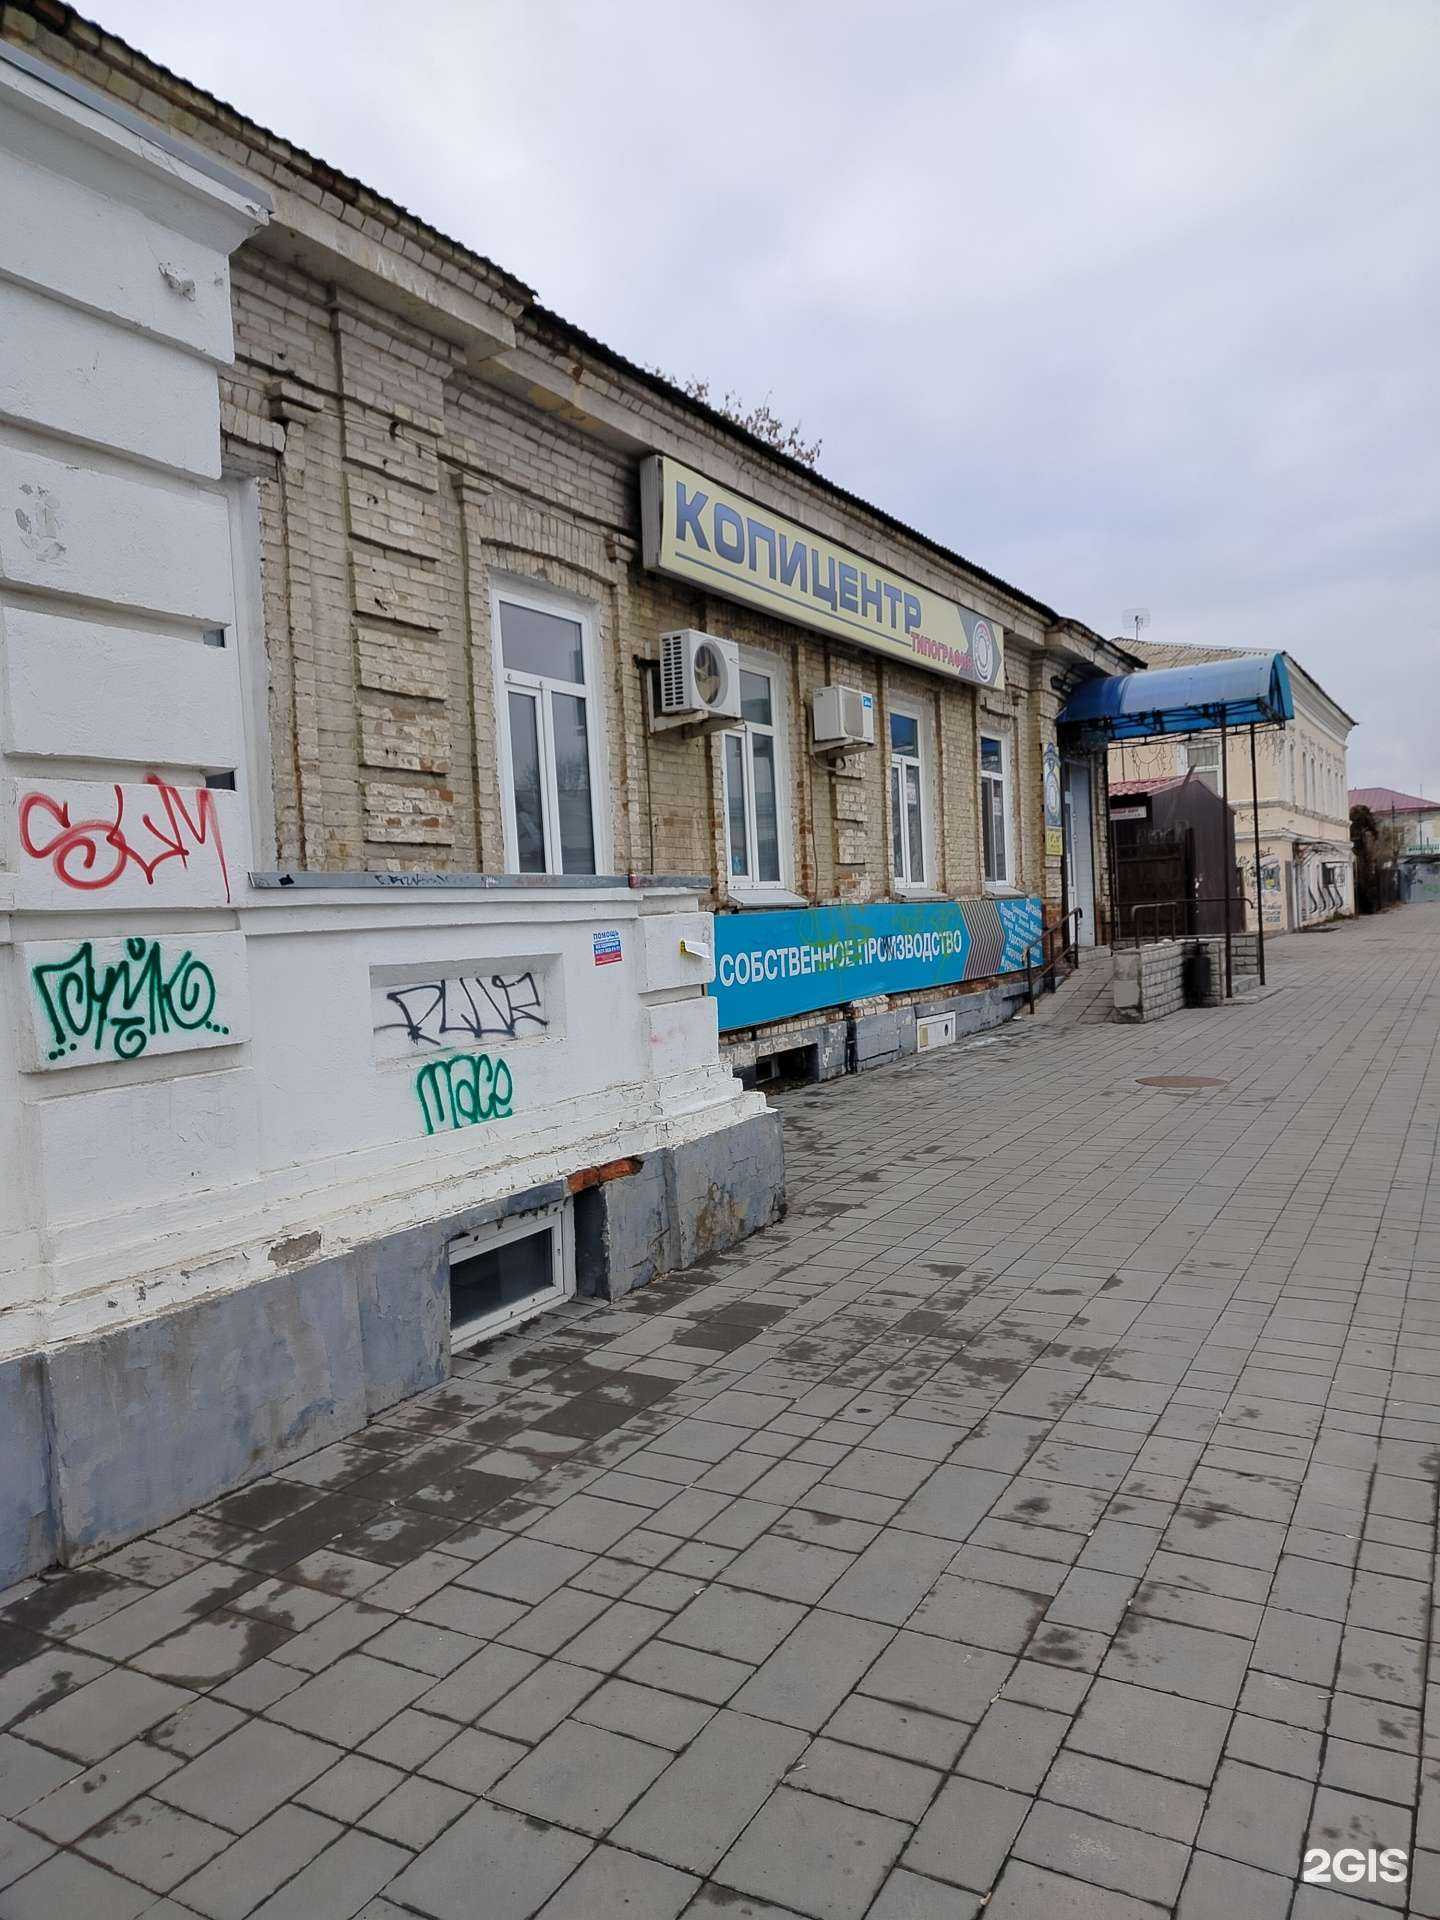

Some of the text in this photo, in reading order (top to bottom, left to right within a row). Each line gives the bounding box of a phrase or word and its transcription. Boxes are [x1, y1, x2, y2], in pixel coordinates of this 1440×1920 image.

[675, 480, 923, 635] КОПИЦЕНТР
[910, 631, 974, 671] ТИПОГРАФИЯ
[718, 937, 856, 988] СОБСТВЕННОЕ
[858, 929, 963, 966] ПРОИЗВОДСТВО
